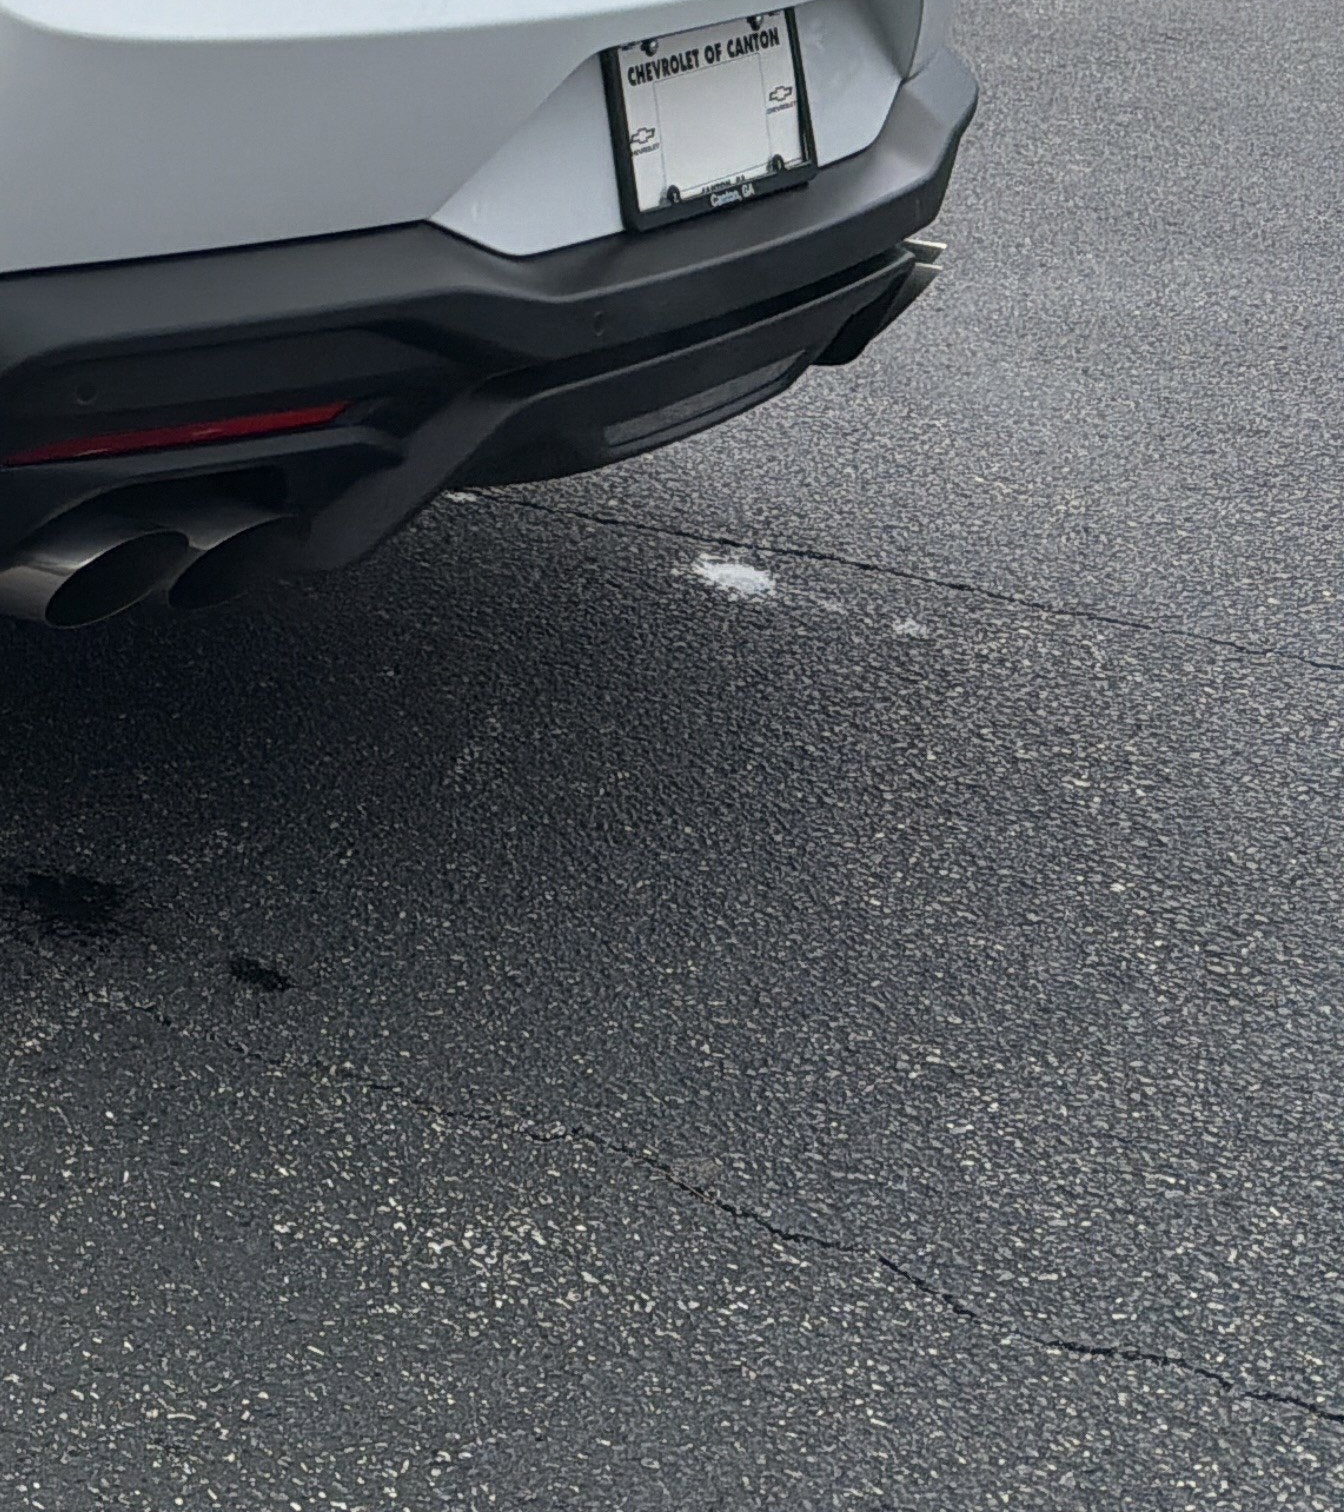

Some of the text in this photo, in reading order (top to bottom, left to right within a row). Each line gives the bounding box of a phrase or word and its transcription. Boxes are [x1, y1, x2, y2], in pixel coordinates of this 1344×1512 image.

[628, 27, 780, 86] CHEVROLET OF CANTON
